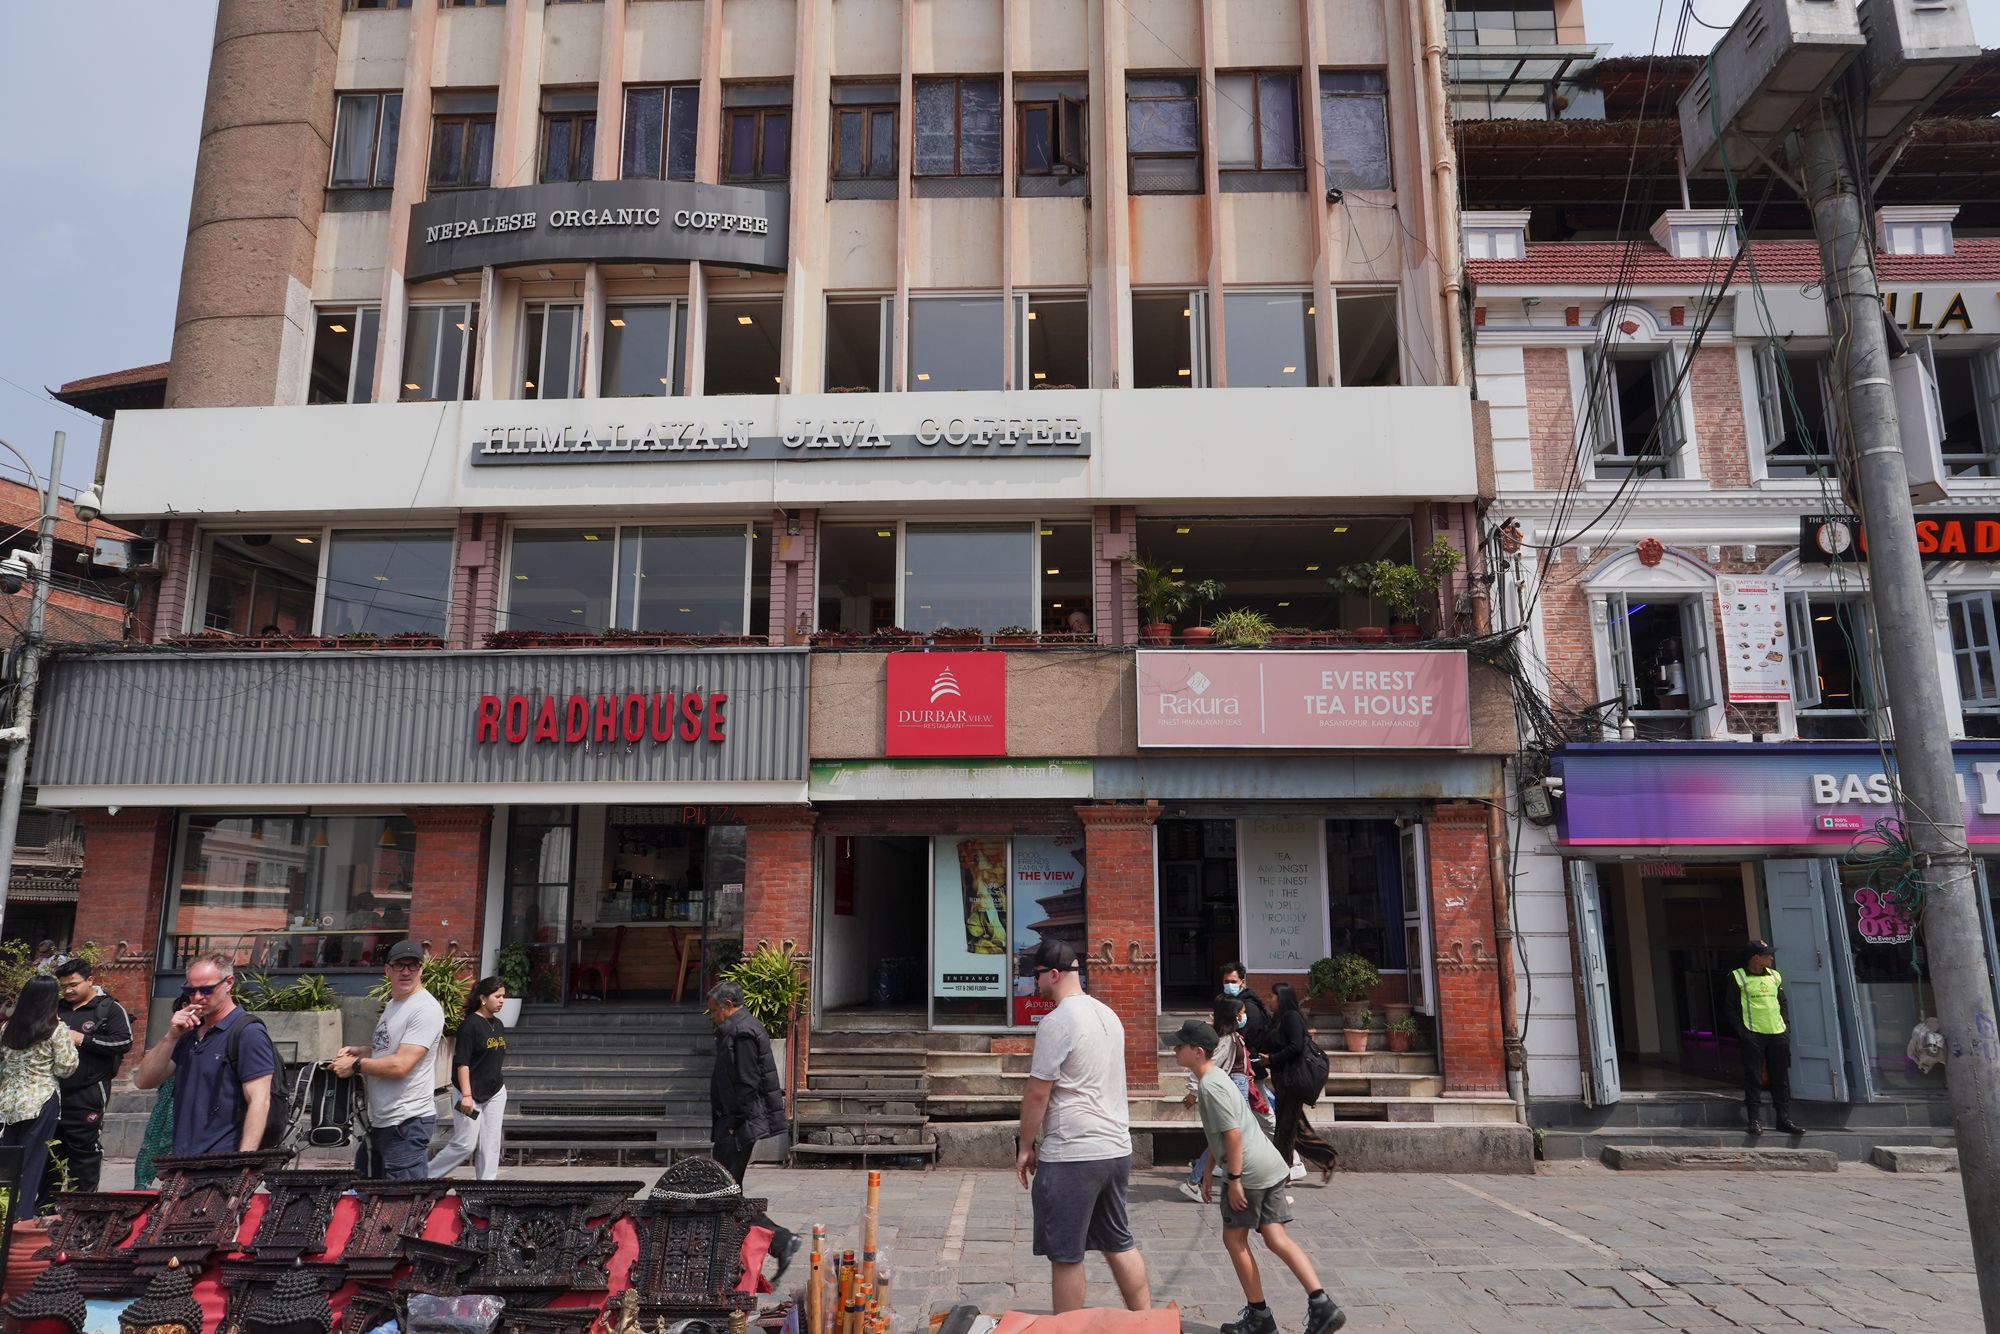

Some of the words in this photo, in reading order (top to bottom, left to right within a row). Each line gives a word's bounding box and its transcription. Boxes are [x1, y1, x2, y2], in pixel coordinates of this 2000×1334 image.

[426, 212, 537, 243] NEPALESE
[549, 208, 660, 228] ORGANIC
[674, 210, 769, 234] COFFEE
[1880, 291, 1973, 331] LLA
[480, 419, 754, 455] HIMALAYAN
[781, 417, 892, 449] JAVA
[915, 415, 1084, 446] COFFEE
[1321, 671, 1415, 690] EVEREST
[1160, 693, 1239, 715] Rakura
[1303, 695, 1346, 715] TEA
[1354, 695, 1433, 715] HOUSE
[477, 694, 727, 744] ROADHOUSE
[899, 710, 967, 722] DURBAR
[1018, 871, 1041, 881] THE
[1043, 871, 1075, 881] VIEW
[1281, 888, 1298, 898] THE
[1270, 926, 1299, 935] MADE
[1860, 919, 1912, 936] OFF
[1280, 938, 1290, 947] IN
